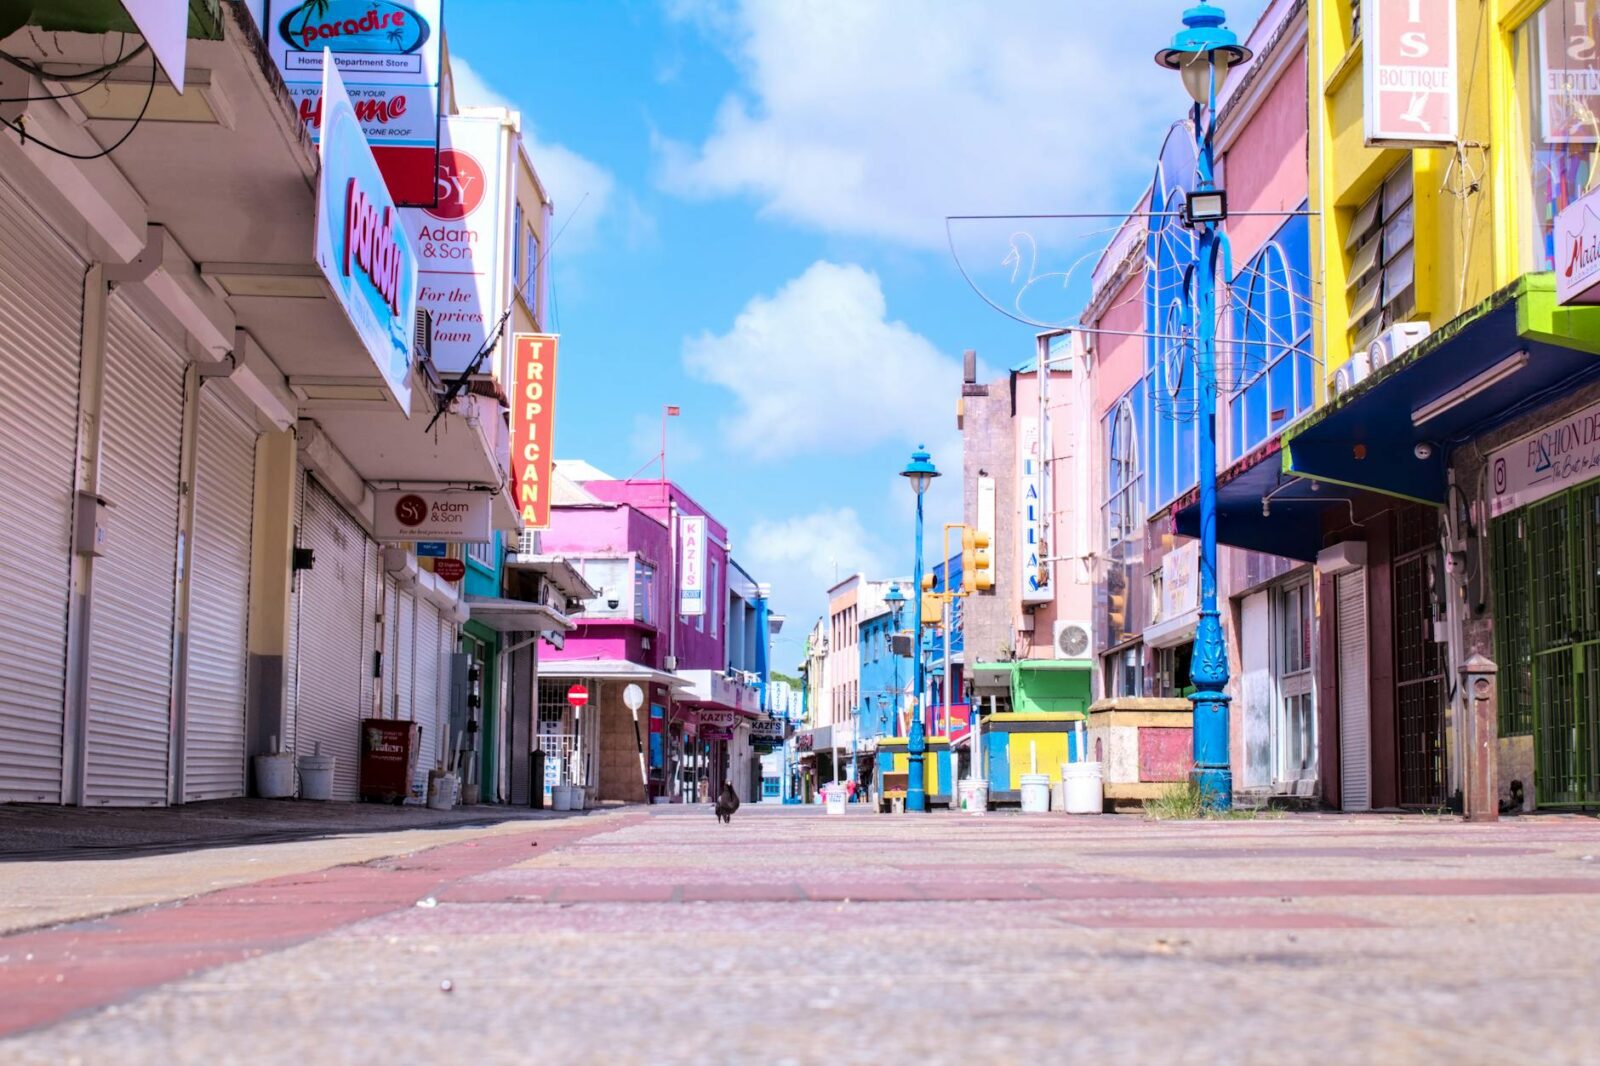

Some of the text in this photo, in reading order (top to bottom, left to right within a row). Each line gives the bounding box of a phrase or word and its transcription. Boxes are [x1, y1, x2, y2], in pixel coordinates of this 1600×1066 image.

[302, 9, 404, 47] paradise
[334, 57, 384, 67] Department
[385, 59, 408, 67] Store
[1379, 69, 1449, 90] BOUTIQUE
[299, 95, 407, 129] Hme
[369, 128, 387, 136] ONE
[418, 225, 478, 242] Adam
[423, 242, 473, 259] & Son
[418, 287, 472, 303] For the
[435, 309, 483, 327] prices
[434, 331, 472, 343] town
[522, 342, 544, 523] TROPICANA
[431, 501, 469, 512] Adam
[431, 512, 463, 523] & Son
[701, 713, 733, 722] KAZI'S
[752, 721, 781, 730] KAZI'S
